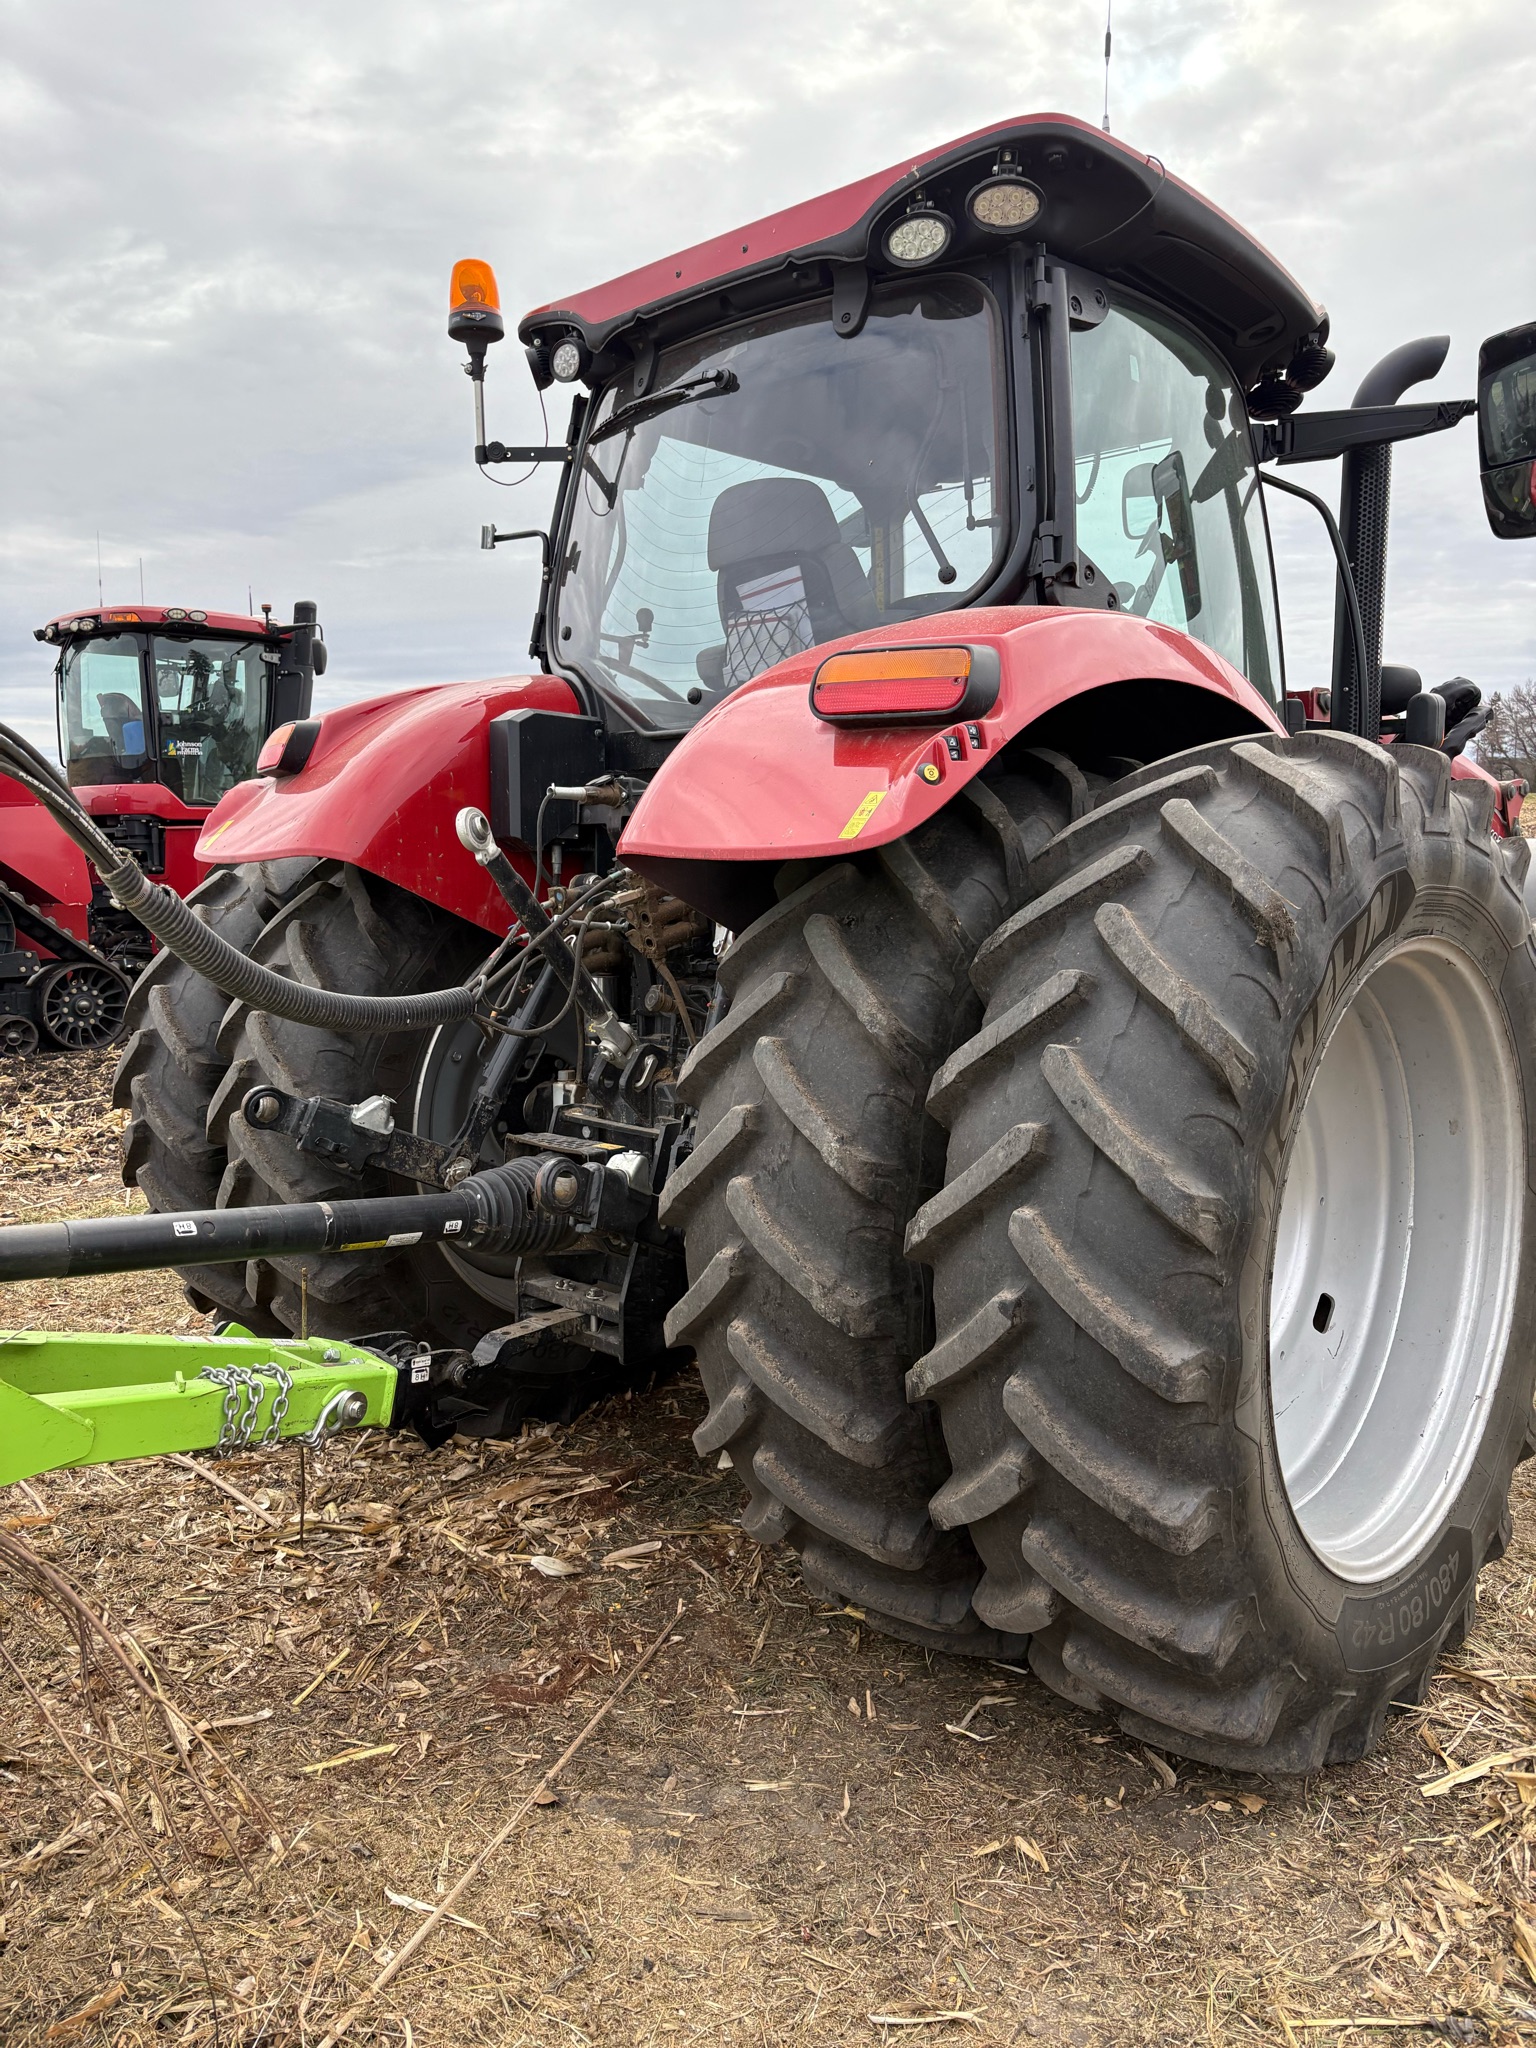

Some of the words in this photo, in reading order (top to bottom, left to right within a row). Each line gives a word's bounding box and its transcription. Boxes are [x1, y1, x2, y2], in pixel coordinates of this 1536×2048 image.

[176, 740, 203, 748] Johnson
[1259, 874, 1396, 1222] MICHELIN
[1399, 1550, 1460, 1637] 480/80
